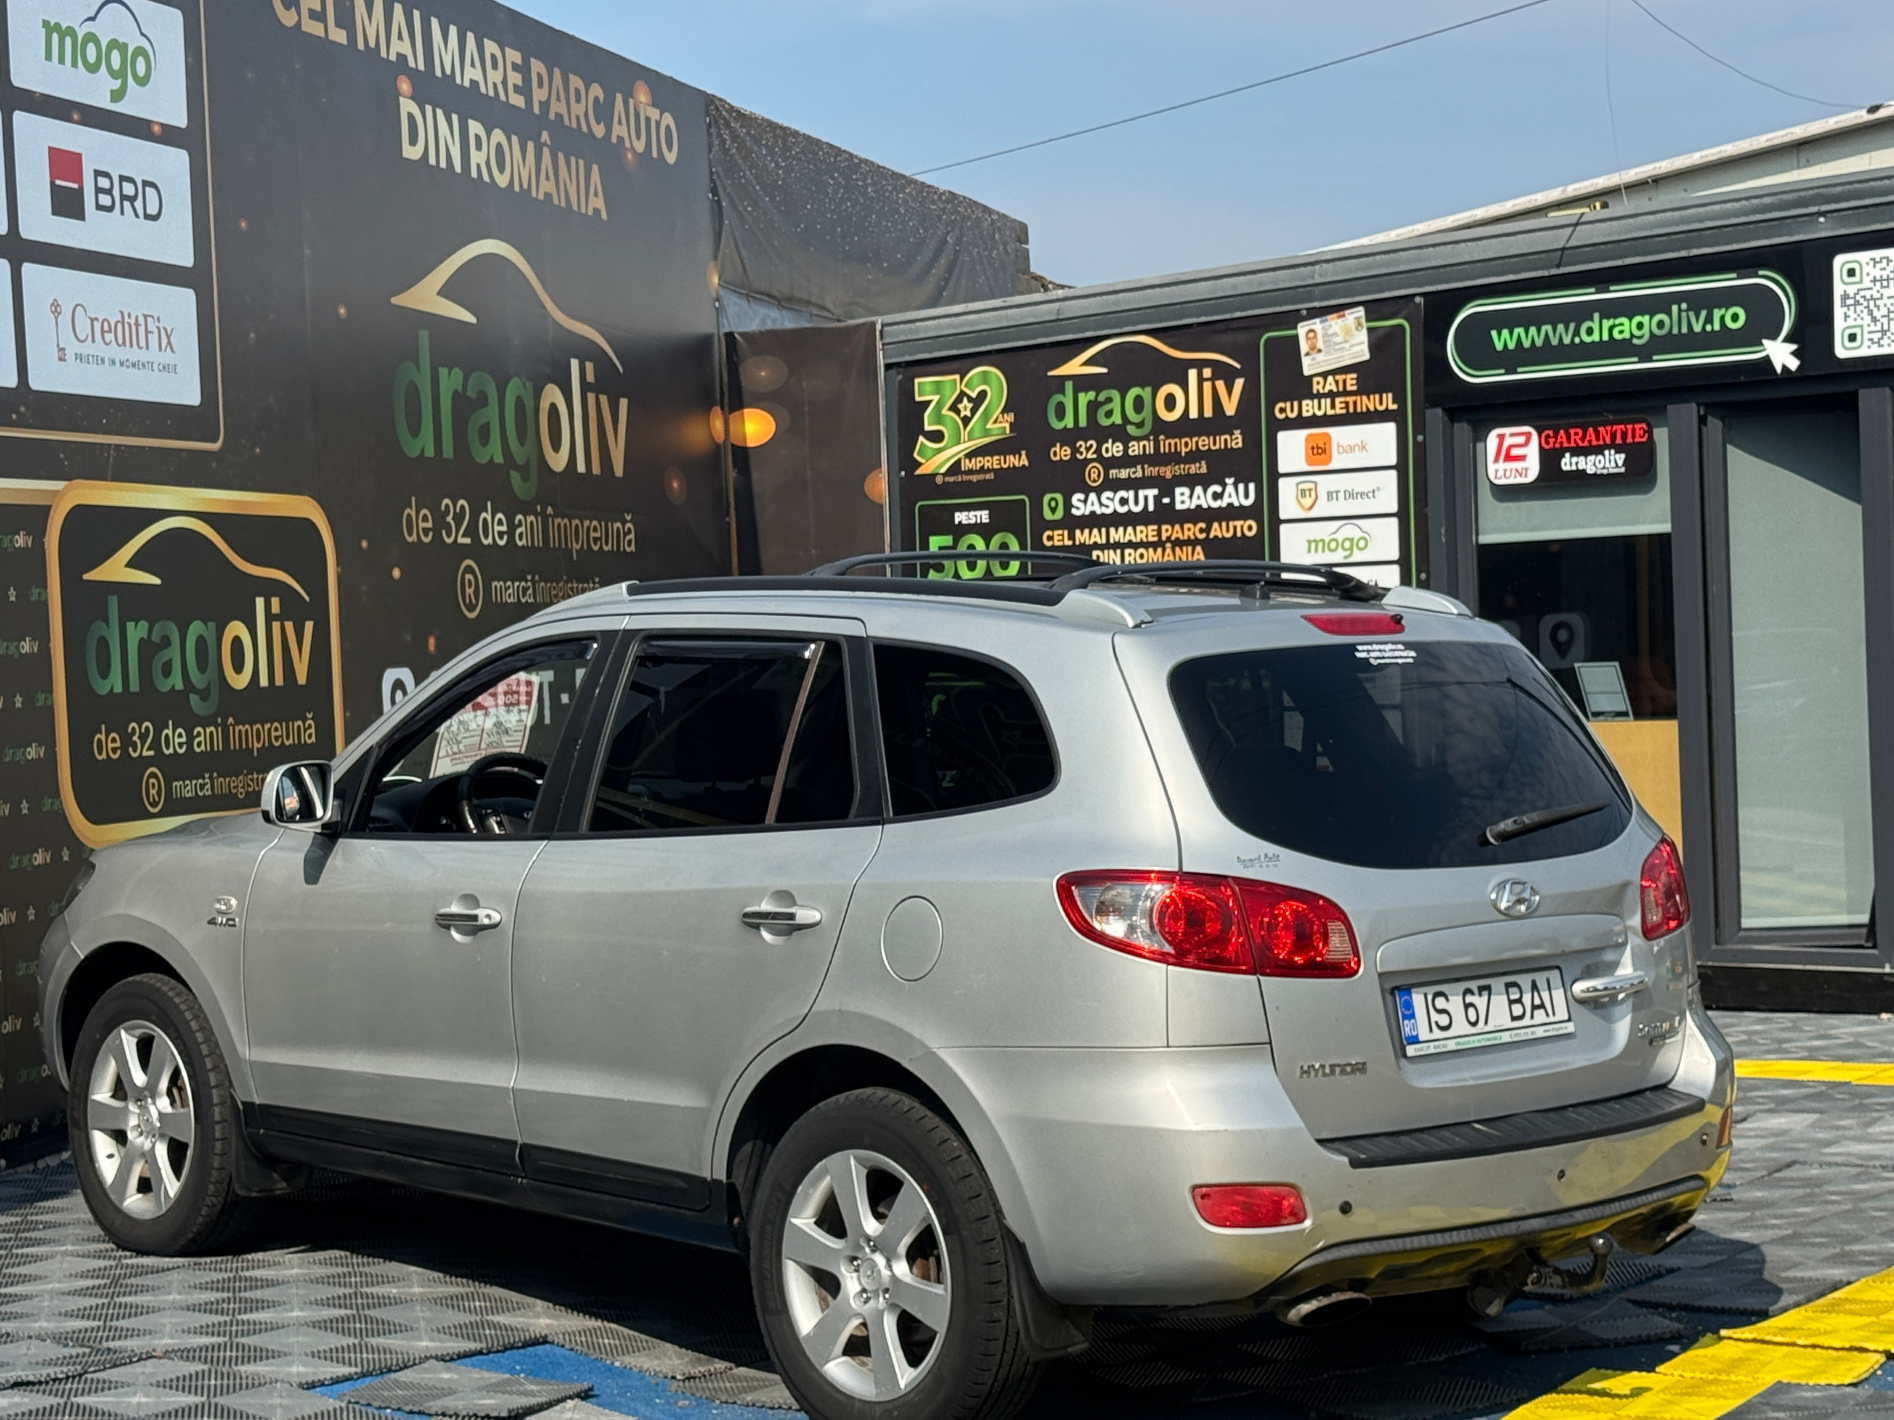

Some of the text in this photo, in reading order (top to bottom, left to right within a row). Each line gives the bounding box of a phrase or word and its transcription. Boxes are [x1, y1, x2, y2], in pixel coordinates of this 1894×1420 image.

[42, 19, 152, 103] mogo
[354, 0, 425, 72] MAI
[430, 16, 526, 110] MARE
[530, 57, 606, 139] PARC
[611, 93, 679, 165] AUTO
[399, 96, 607, 221] DIN ROMÂNIA
[93, 169, 163, 222] BRD
[71, 303, 176, 354] CreditFix
[1490, 302, 1746, 352] www.dragoliv.ro
[74, 352, 105, 366] PRIETEN
[108, 356, 116, 367] IN
[119, 358, 154, 372] MOMENTE
[1312, 373, 1358, 394] RATE
[393, 329, 628, 501] dragoliv
[913, 365, 1010, 463] 32
[1047, 367, 1245, 436] dragoliv
[1274, 393, 1398, 419] CU BULETINUL
[1050, 430, 1243, 460] de 32 de ani împreună
[1310, 440, 1368, 456] tbi bank
[1492, 431, 1532, 464] 12
[1540, 422, 1649, 450] GARANTIE
[961, 450, 1029, 471] ÎMPREUNĂ
[1109, 463, 1142, 480] marcă
[1144, 460, 1207, 479] înregistrată
[1494, 467, 1530, 480] LUNI
[1560, 449, 1626, 475] dragoliv
[1070, 488, 1159, 516] SASCUT
[1174, 477, 1256, 510] BACĂU
[1300, 488, 1313, 499] BT
[1326, 490, 1341, 502] BT
[402, 496, 636, 560] de 32 de ani împreună
[954, 510, 990, 525] PESTE
[1043, 520, 1257, 546] CEL MAI MARE PARC AUTO
[928, 532, 1020, 580] 500
[1092, 544, 1206, 565] DIN ROMÂNIA
[1306, 536, 1369, 560] mogo
[491, 574, 535, 603] marcă
[85, 595, 314, 716] dragoliv
[93, 711, 316, 760] de 32 de ani împreună
[172, 772, 212, 799] marcă
[213, 770, 267, 799] înregistr
[1404, 976, 1556, 1037] RO IS 67 BAI
[1299, 1062, 1367, 1079] HYUNDAI
